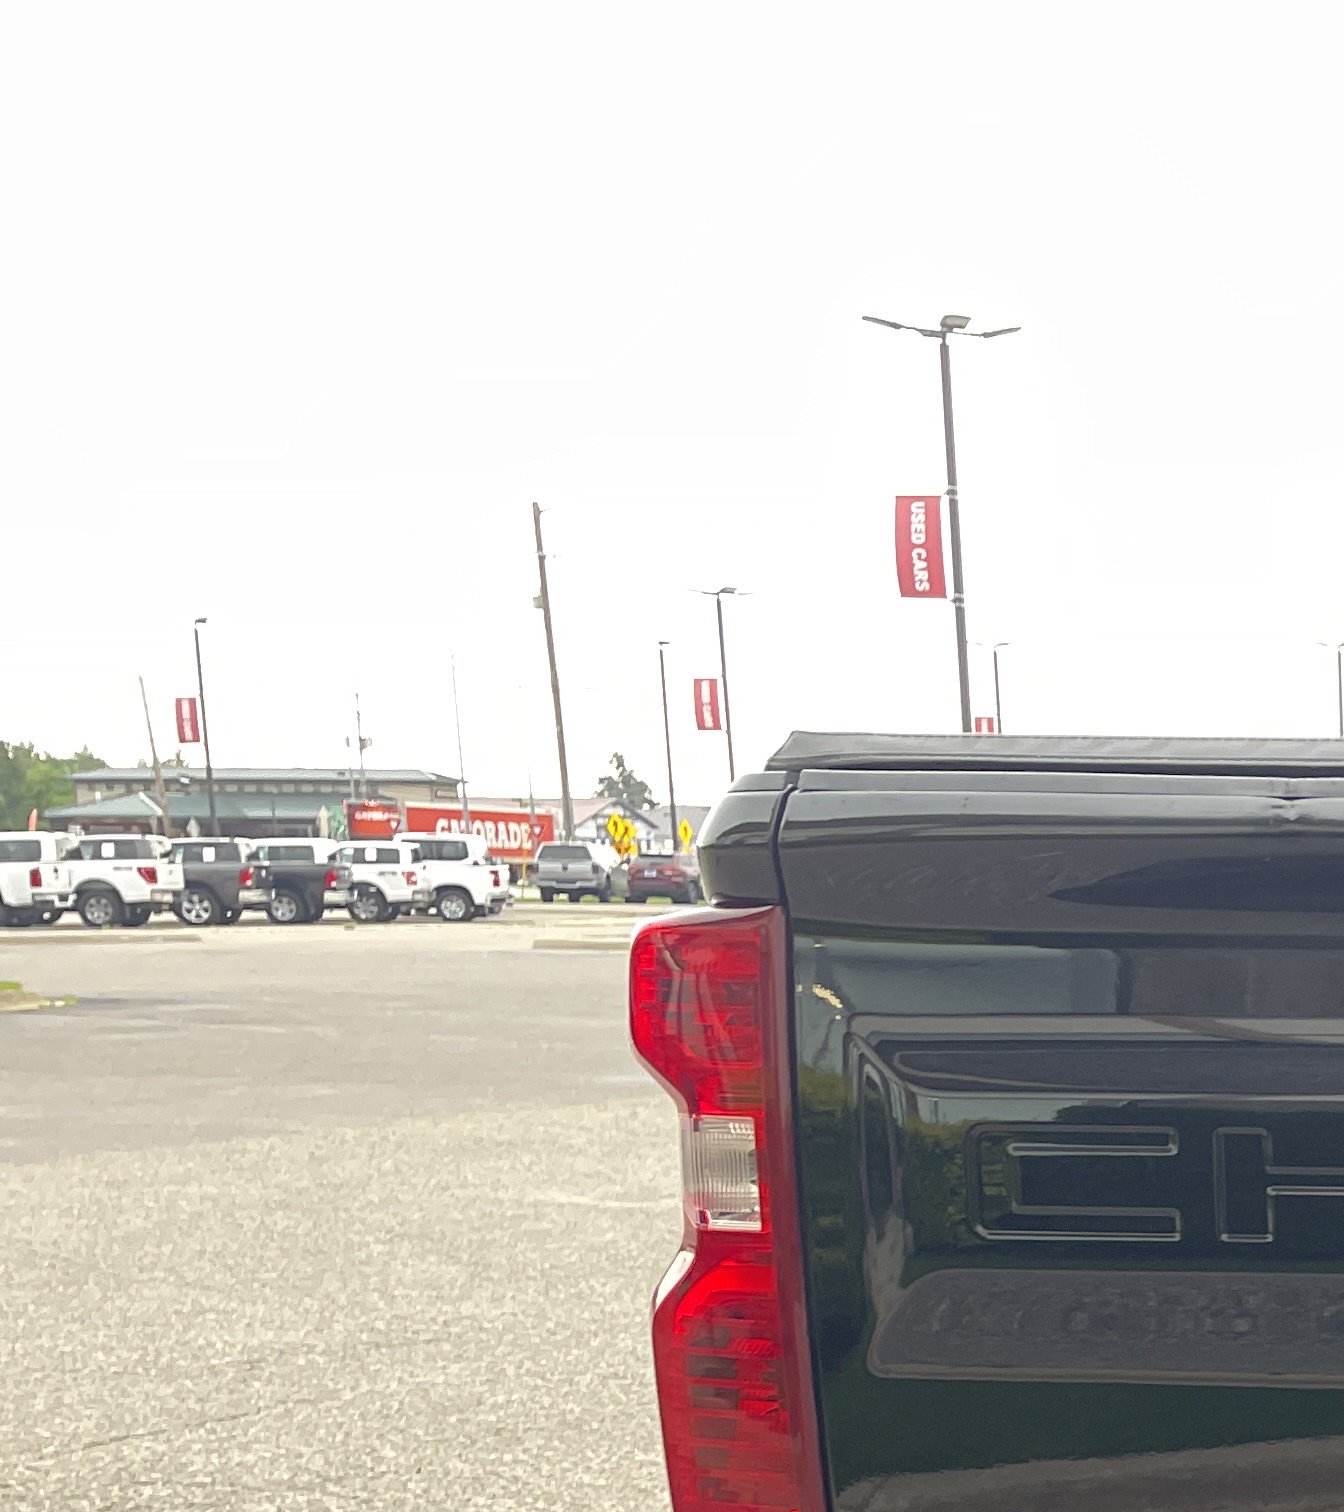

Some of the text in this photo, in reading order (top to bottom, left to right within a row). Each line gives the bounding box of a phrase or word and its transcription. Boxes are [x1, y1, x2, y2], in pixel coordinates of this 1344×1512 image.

[910, 501, 931, 592] USED CARS
[435, 818, 532, 850] GAORADE
